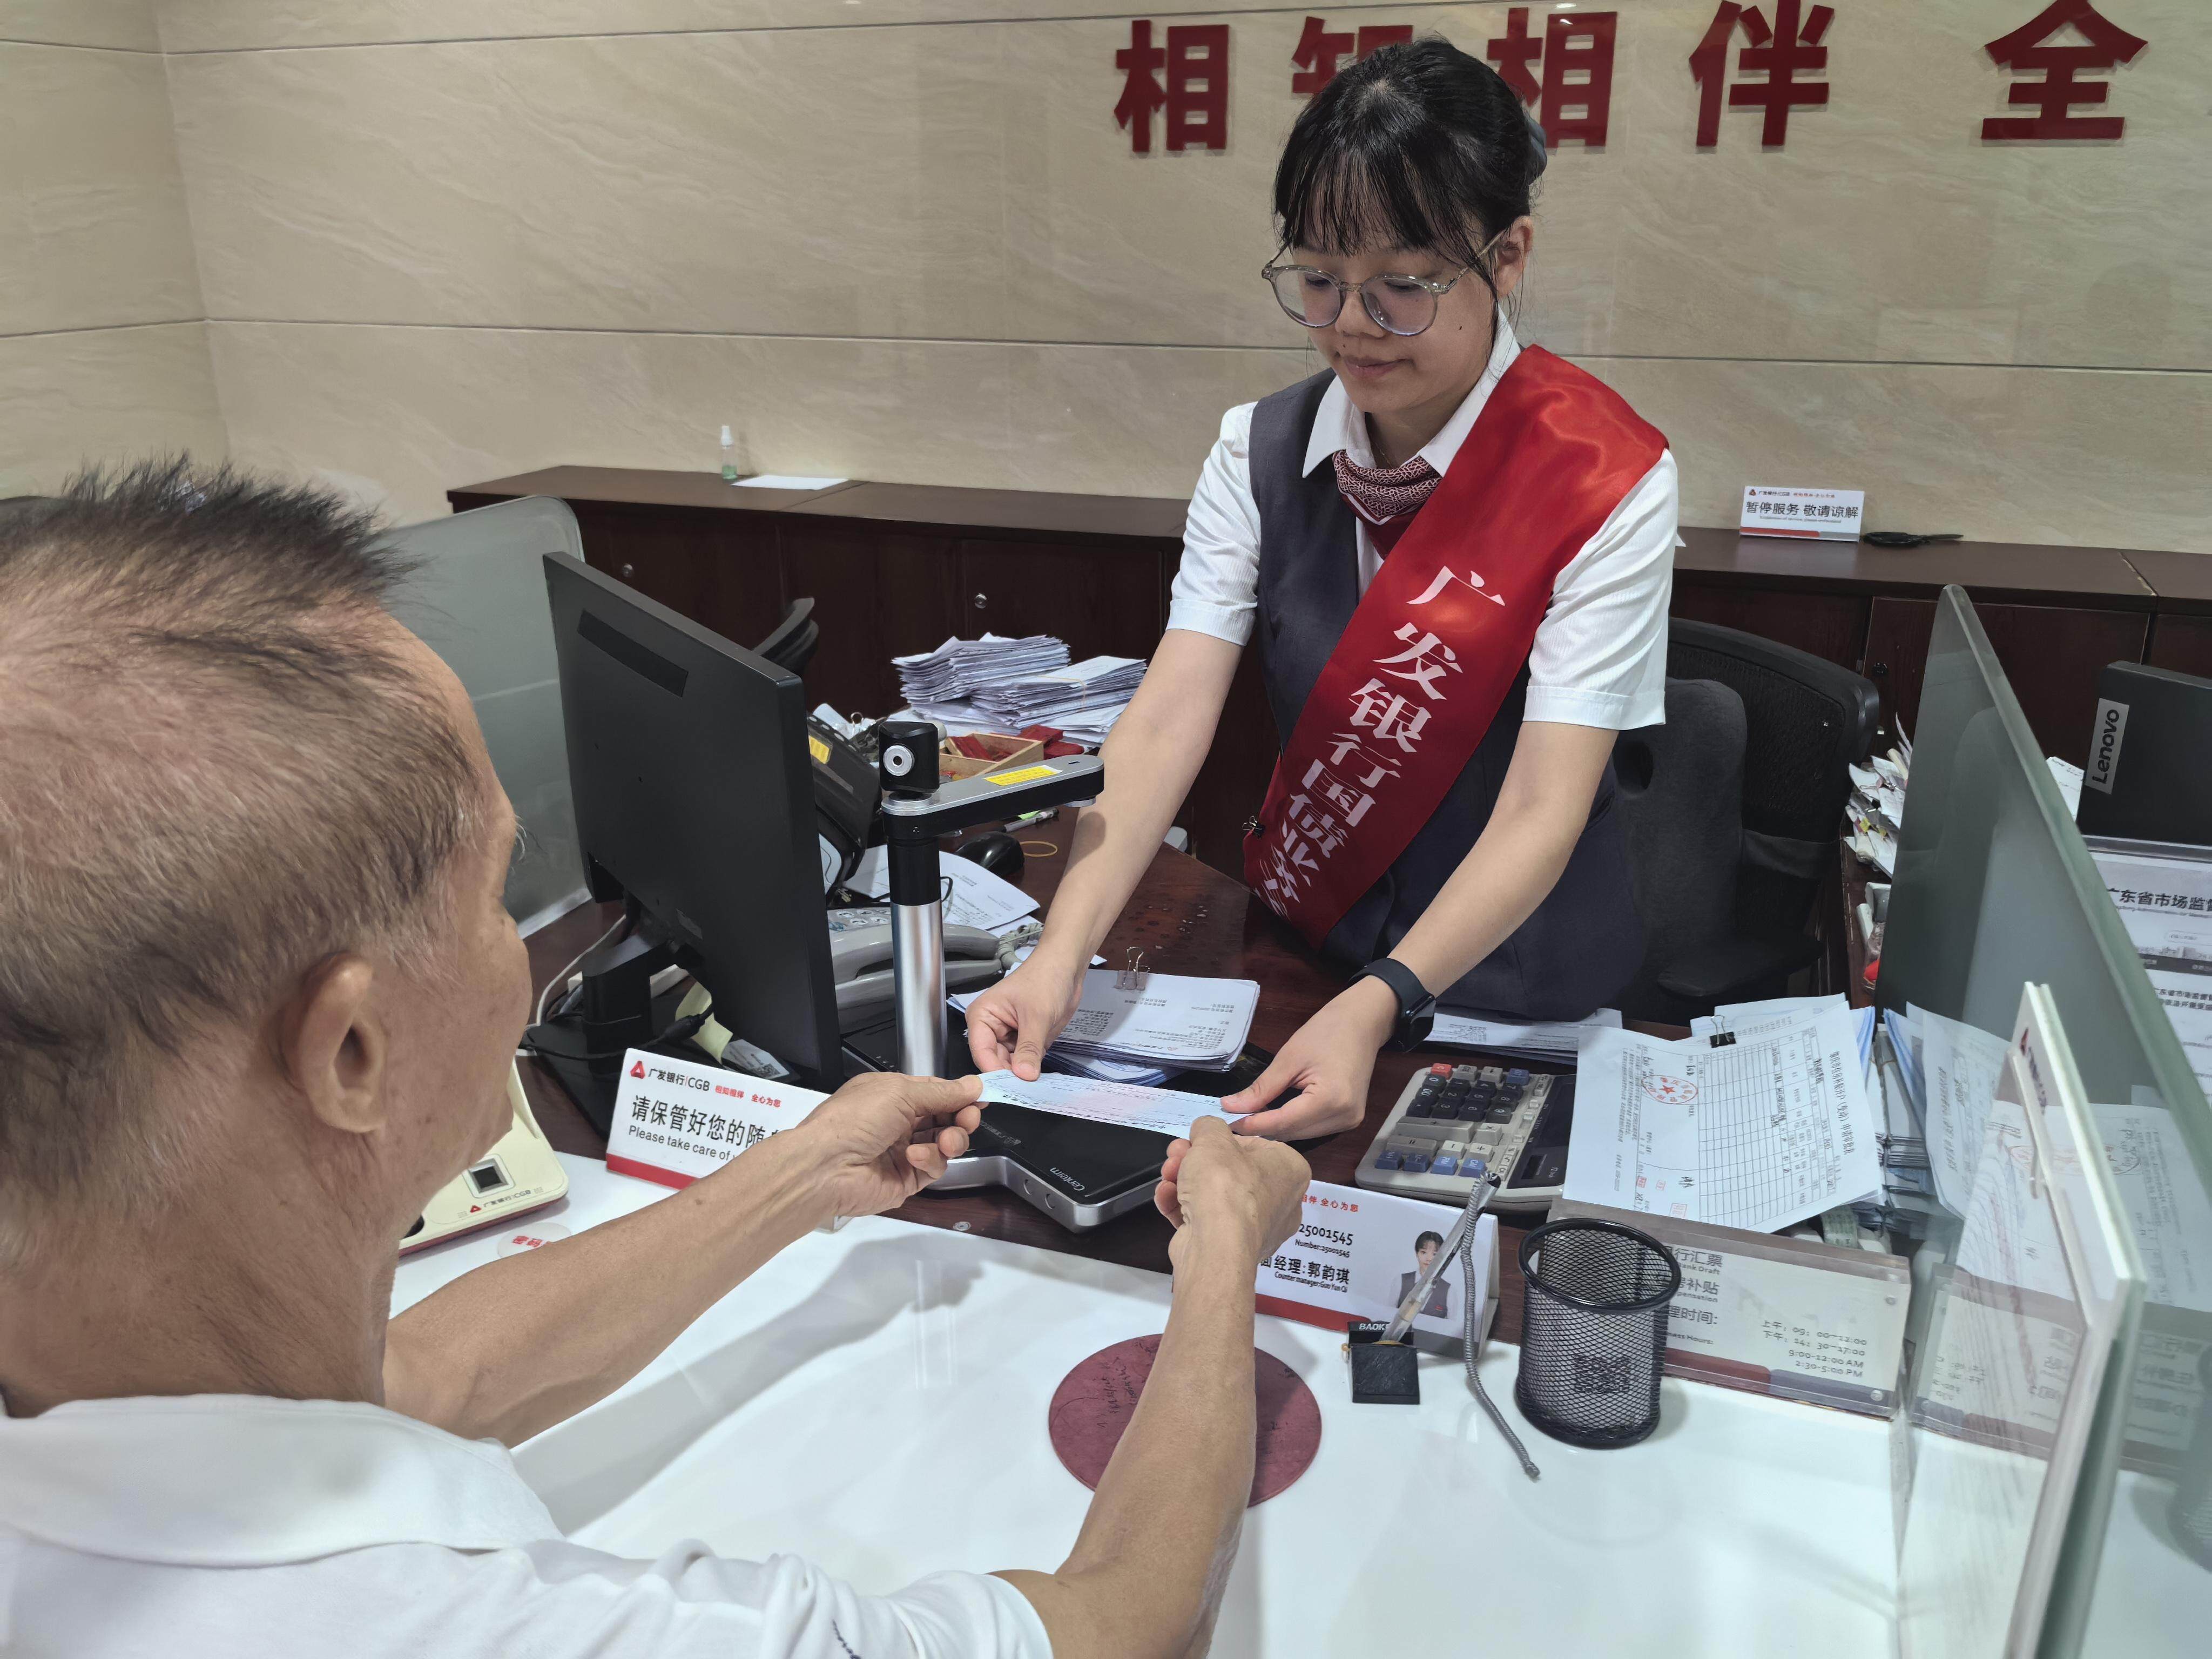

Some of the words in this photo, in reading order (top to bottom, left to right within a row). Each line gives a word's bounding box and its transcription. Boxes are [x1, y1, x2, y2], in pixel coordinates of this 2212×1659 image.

[1984, 0, 2148, 139] 全
[1746, 502, 1799, 516] 暂停服务
[1803, 504, 1858, 518] 敬请谅解
[2092, 709, 2120, 784] Lenovo
[2108, 888, 2212, 912] 东省市场监
[649, 1068, 685, 1085] 广发银行
[688, 1077, 710, 1091] CGB
[751, 1094, 781, 1108] 全心为您
[632, 1095, 778, 1148] 请保管好您的随
[629, 1125, 665, 1144] Please
[667, 1135, 690, 1150] take
[692, 1144, 717, 1157] care
[719, 1150, 731, 1161] of
[1050, 1166, 1085, 1191] Centerm
[1320, 1198, 1359, 1212] 全心为您
[1298, 1224, 1353, 1245] 25001545
[1668, 1246, 1723, 1267] 行汇票
[1846, 1359, 1863, 1368] AM
[1846, 1368, 1863, 1377] PM
